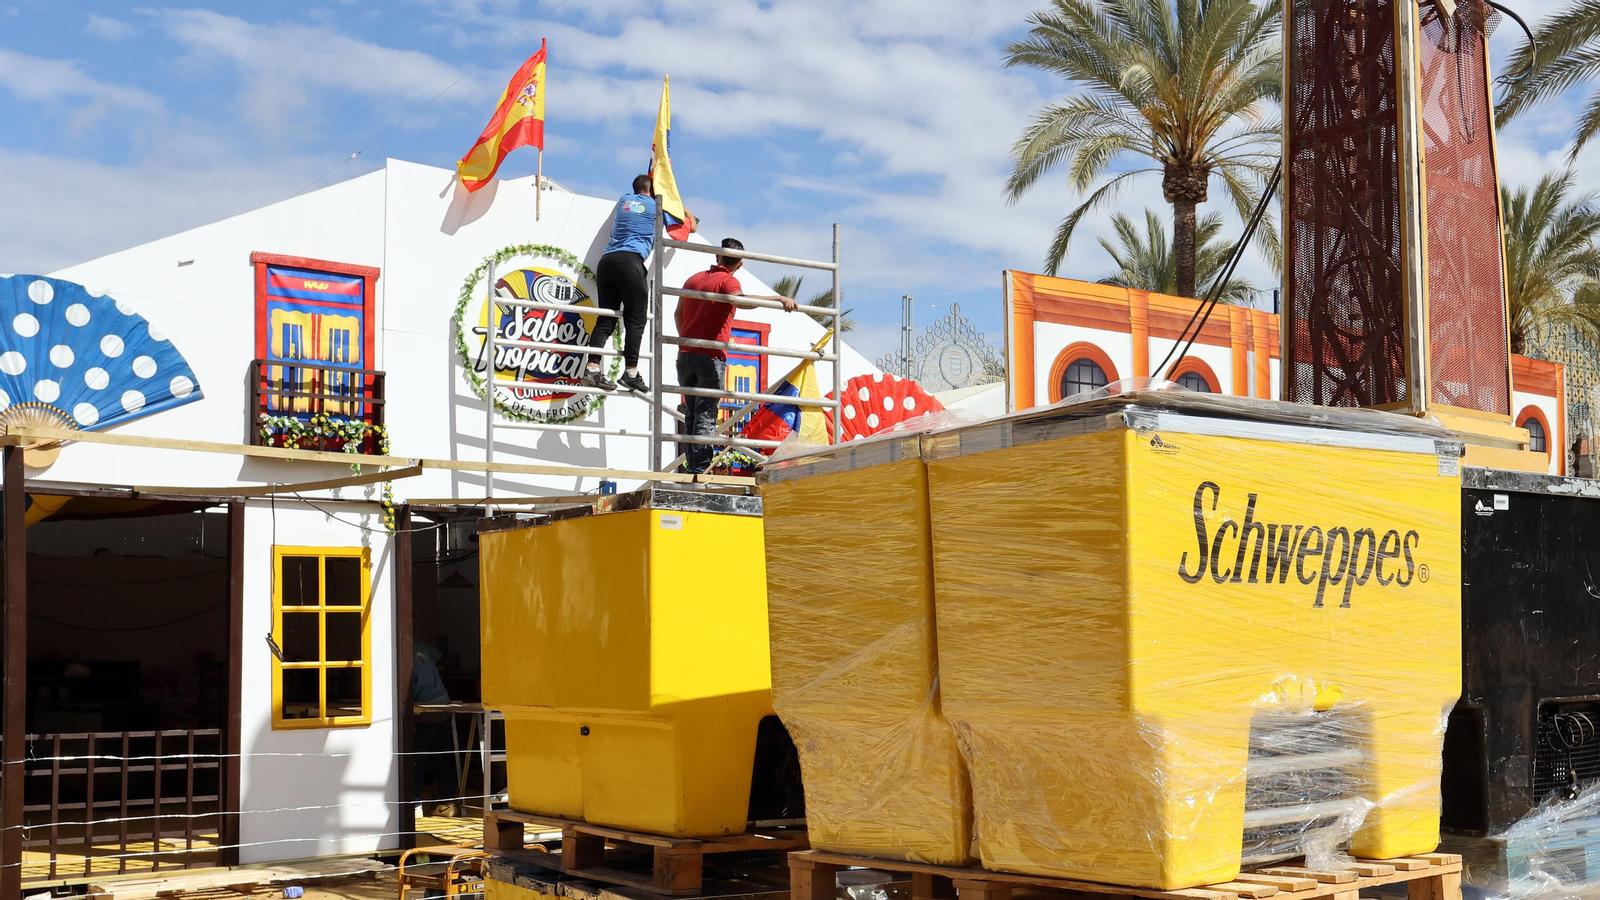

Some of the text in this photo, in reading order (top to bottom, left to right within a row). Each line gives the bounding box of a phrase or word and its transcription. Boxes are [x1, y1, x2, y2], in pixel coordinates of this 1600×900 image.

[505, 305, 590, 346] Sabor
[472, 326, 589, 381] Tropical
[546, 393, 594, 418] FRONTER
[1178, 480, 1420, 608] Schweppes
